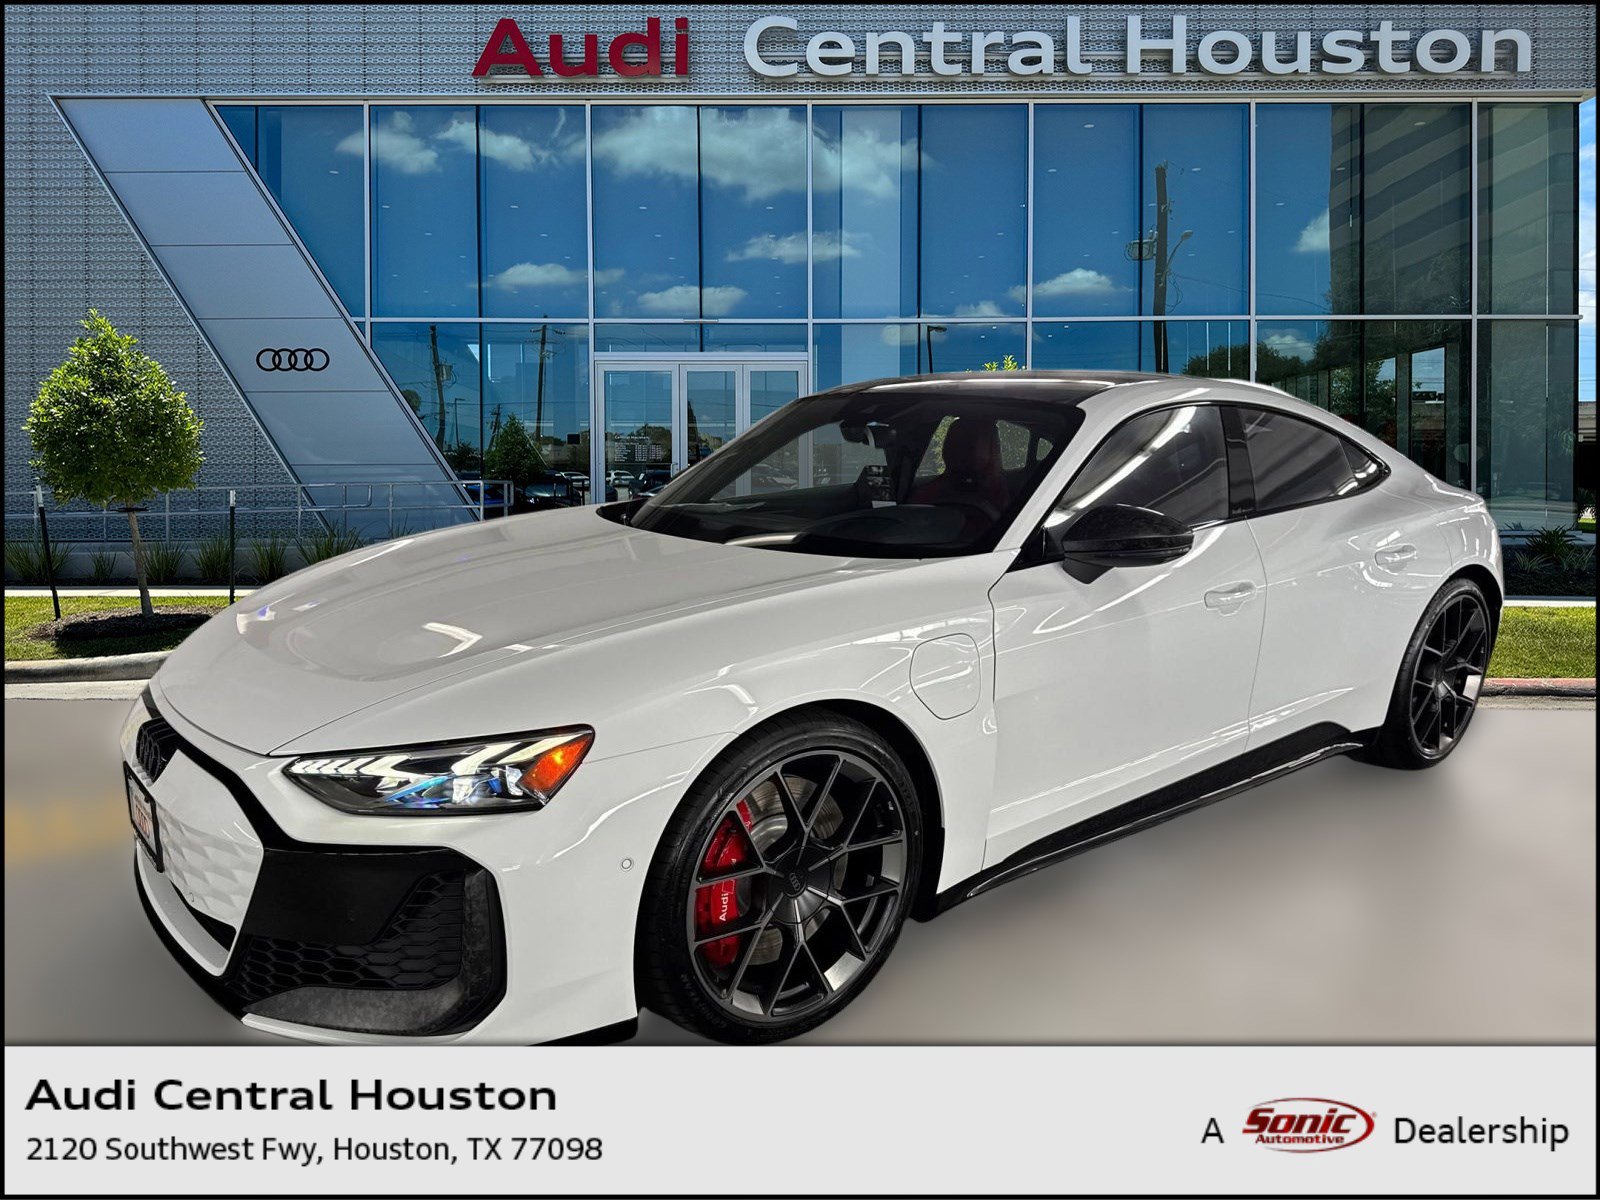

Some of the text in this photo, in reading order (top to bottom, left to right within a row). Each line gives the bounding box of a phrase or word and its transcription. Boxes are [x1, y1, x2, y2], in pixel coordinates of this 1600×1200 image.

[471, 15, 1533, 78] Audi Central Houston
[719, 892, 729, 922] Audi
